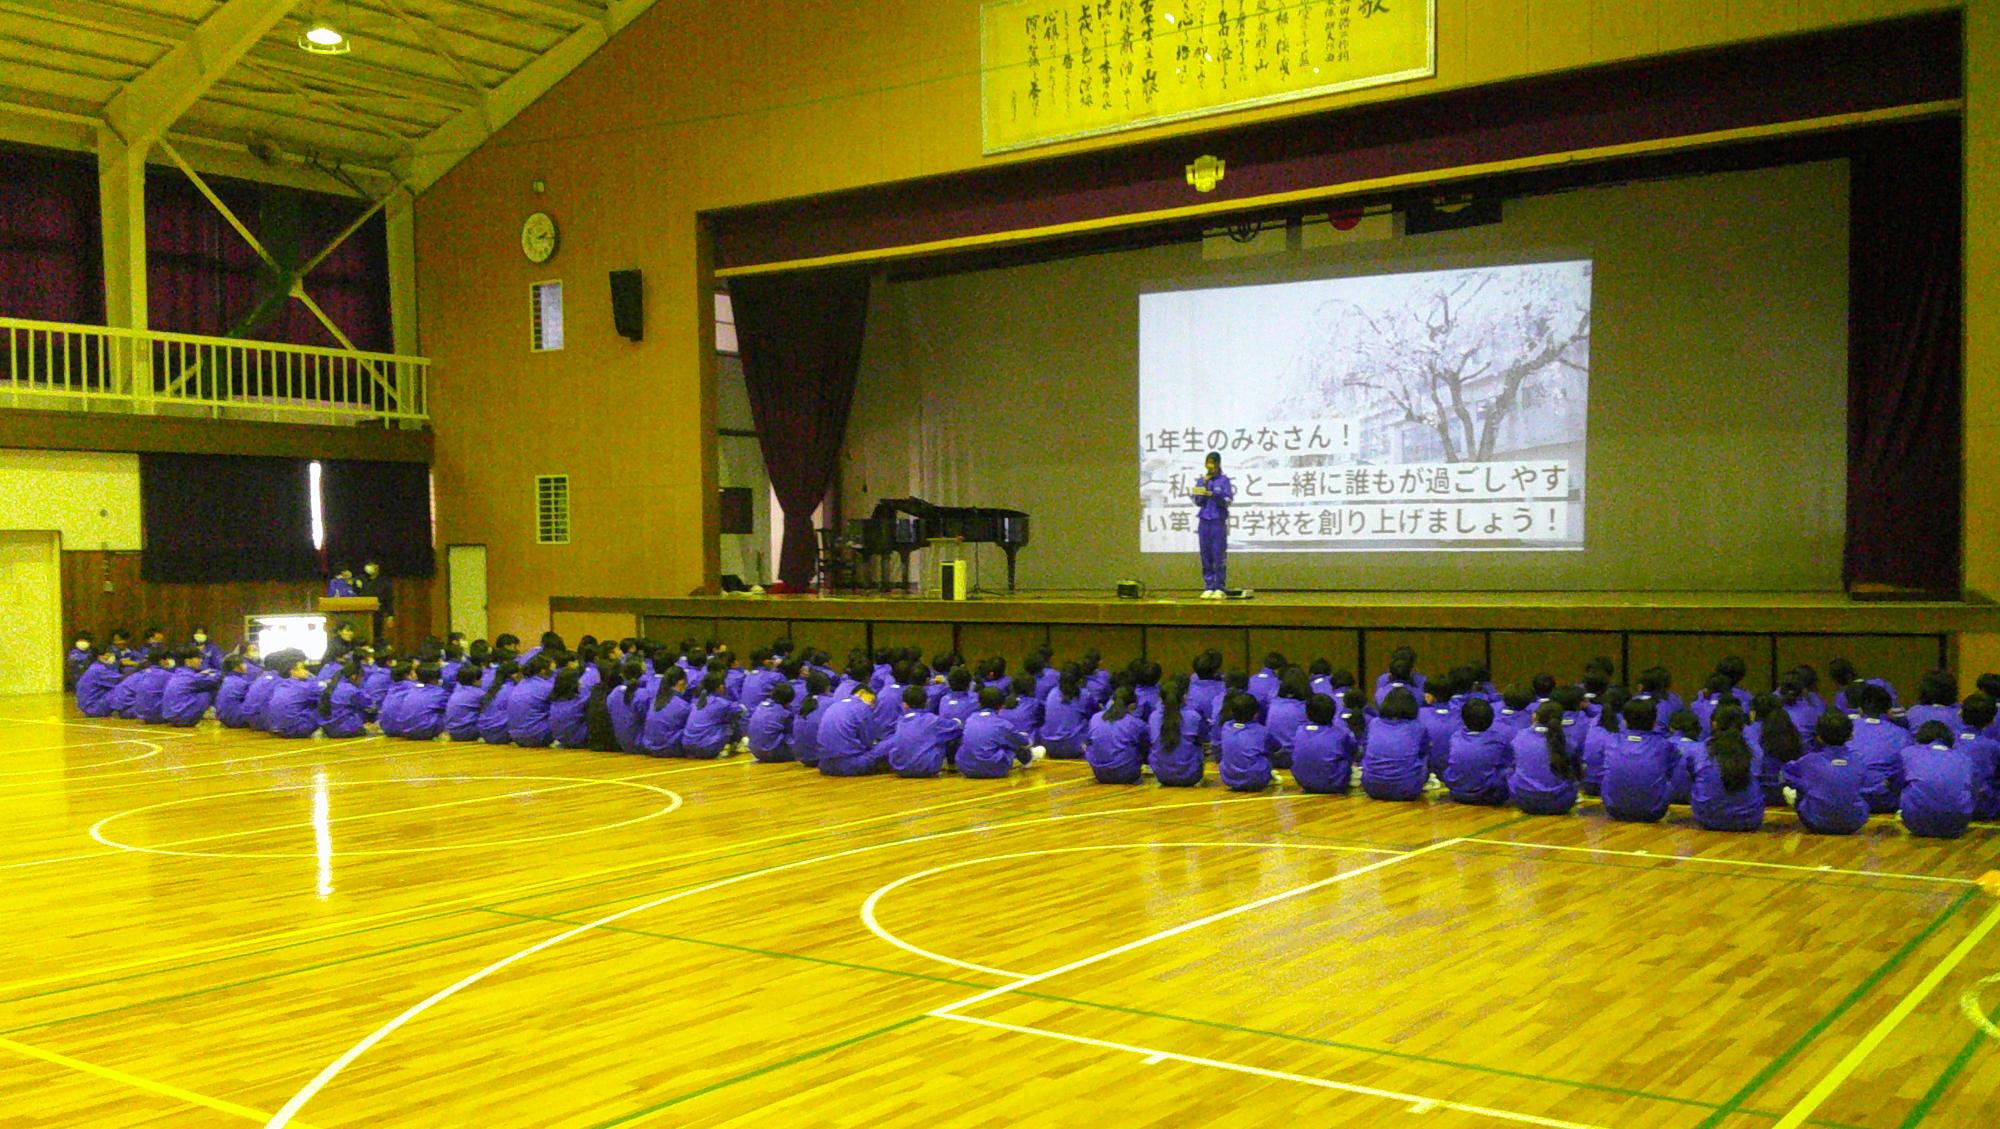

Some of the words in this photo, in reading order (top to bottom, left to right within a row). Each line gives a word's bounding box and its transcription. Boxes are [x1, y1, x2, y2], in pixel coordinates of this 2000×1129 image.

[1169, 465, 1567, 498] 私と一緒に誰もが過ごしやす
[1146, 508, 1556, 537] い第中学校を創り上げましょう！
